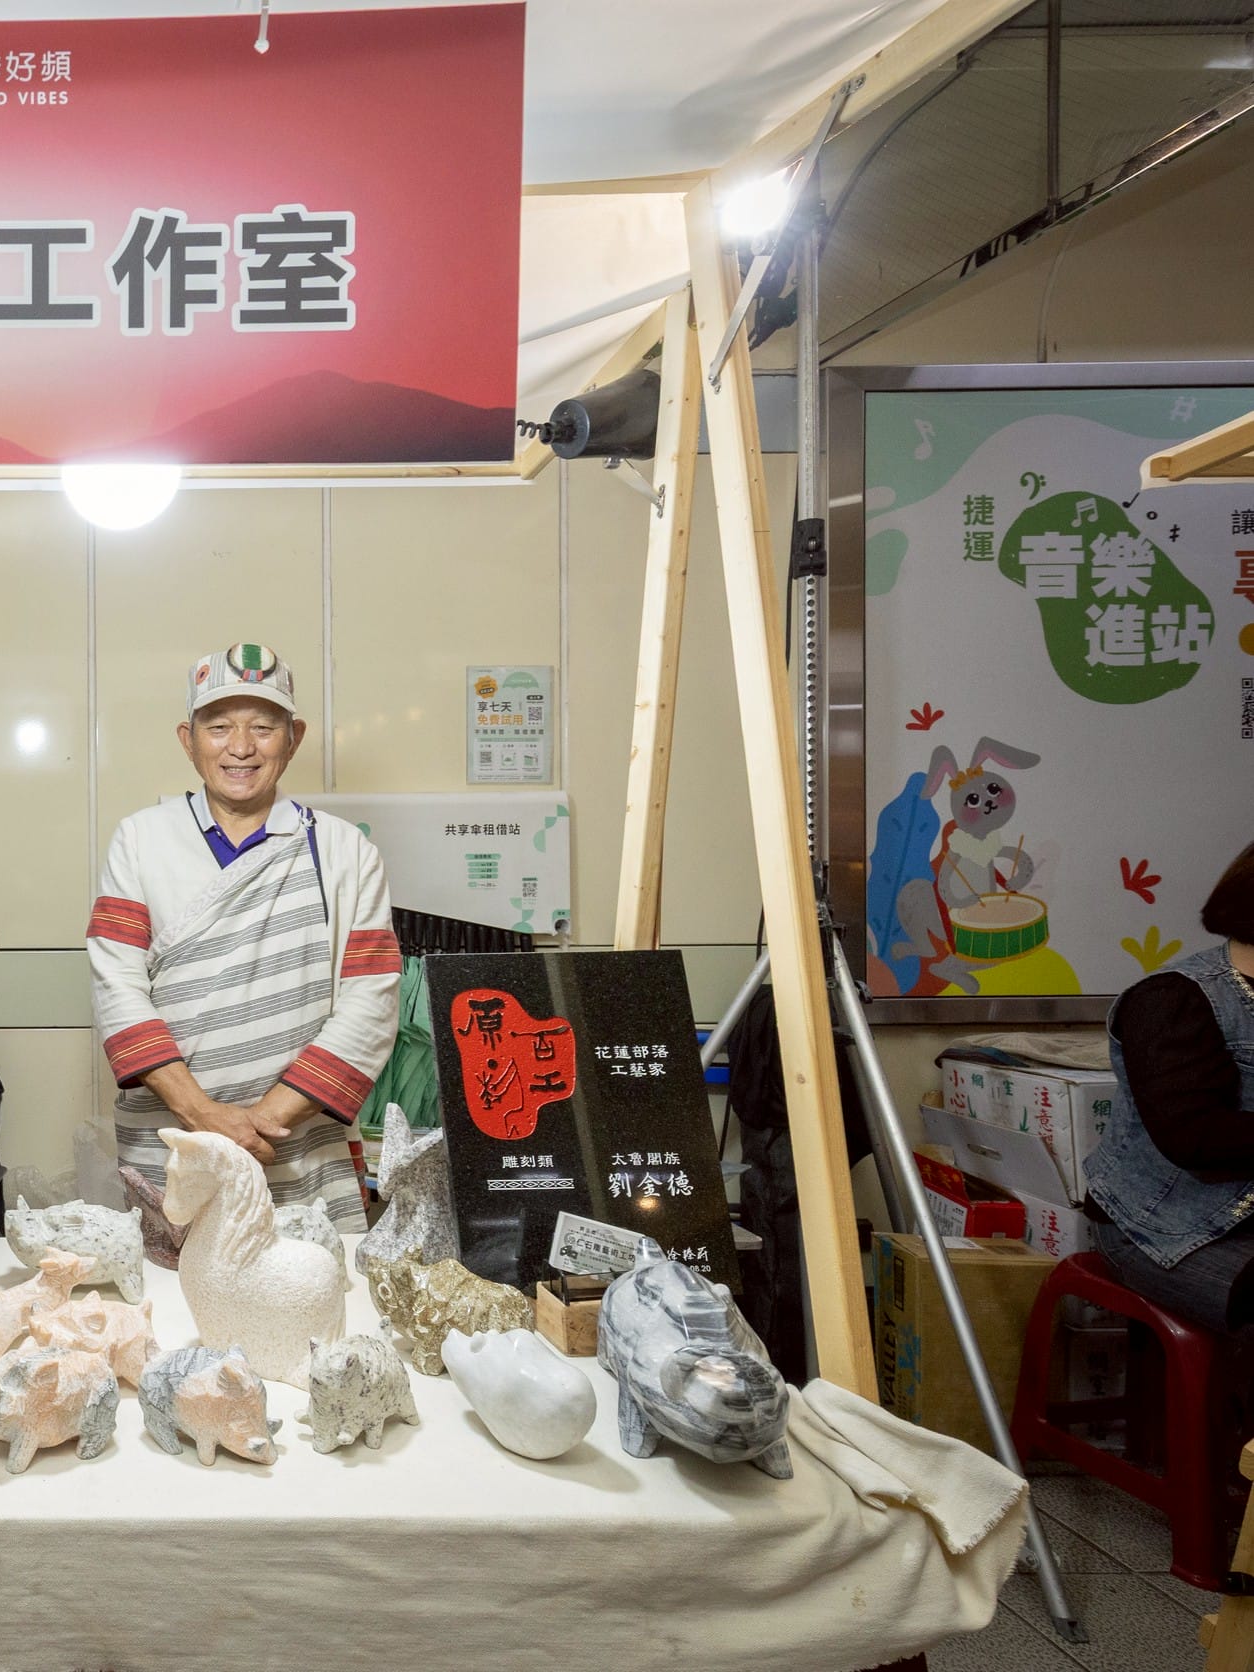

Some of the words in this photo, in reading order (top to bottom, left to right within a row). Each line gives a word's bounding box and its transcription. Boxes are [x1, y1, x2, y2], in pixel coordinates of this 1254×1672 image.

[17, 91, 69, 105] VIBES
[962, 494, 996, 562] 捷運
[1018, 530, 1157, 600] 音樂
[1083, 603, 1212, 667] 進站
[477, 701, 512, 712] 享七天
[444, 823, 521, 836] 共享傘租借站
[594, 1044, 670, 1059] 花蓮部落
[610, 1062, 667, 1077] 工藝家
[502, 1154, 555, 1169] 雕刻類
[611, 1151, 681, 1166] 太魯閣族
[608, 1169, 694, 1198] 劉金德
[882, 1312, 896, 1406] VALLEY
